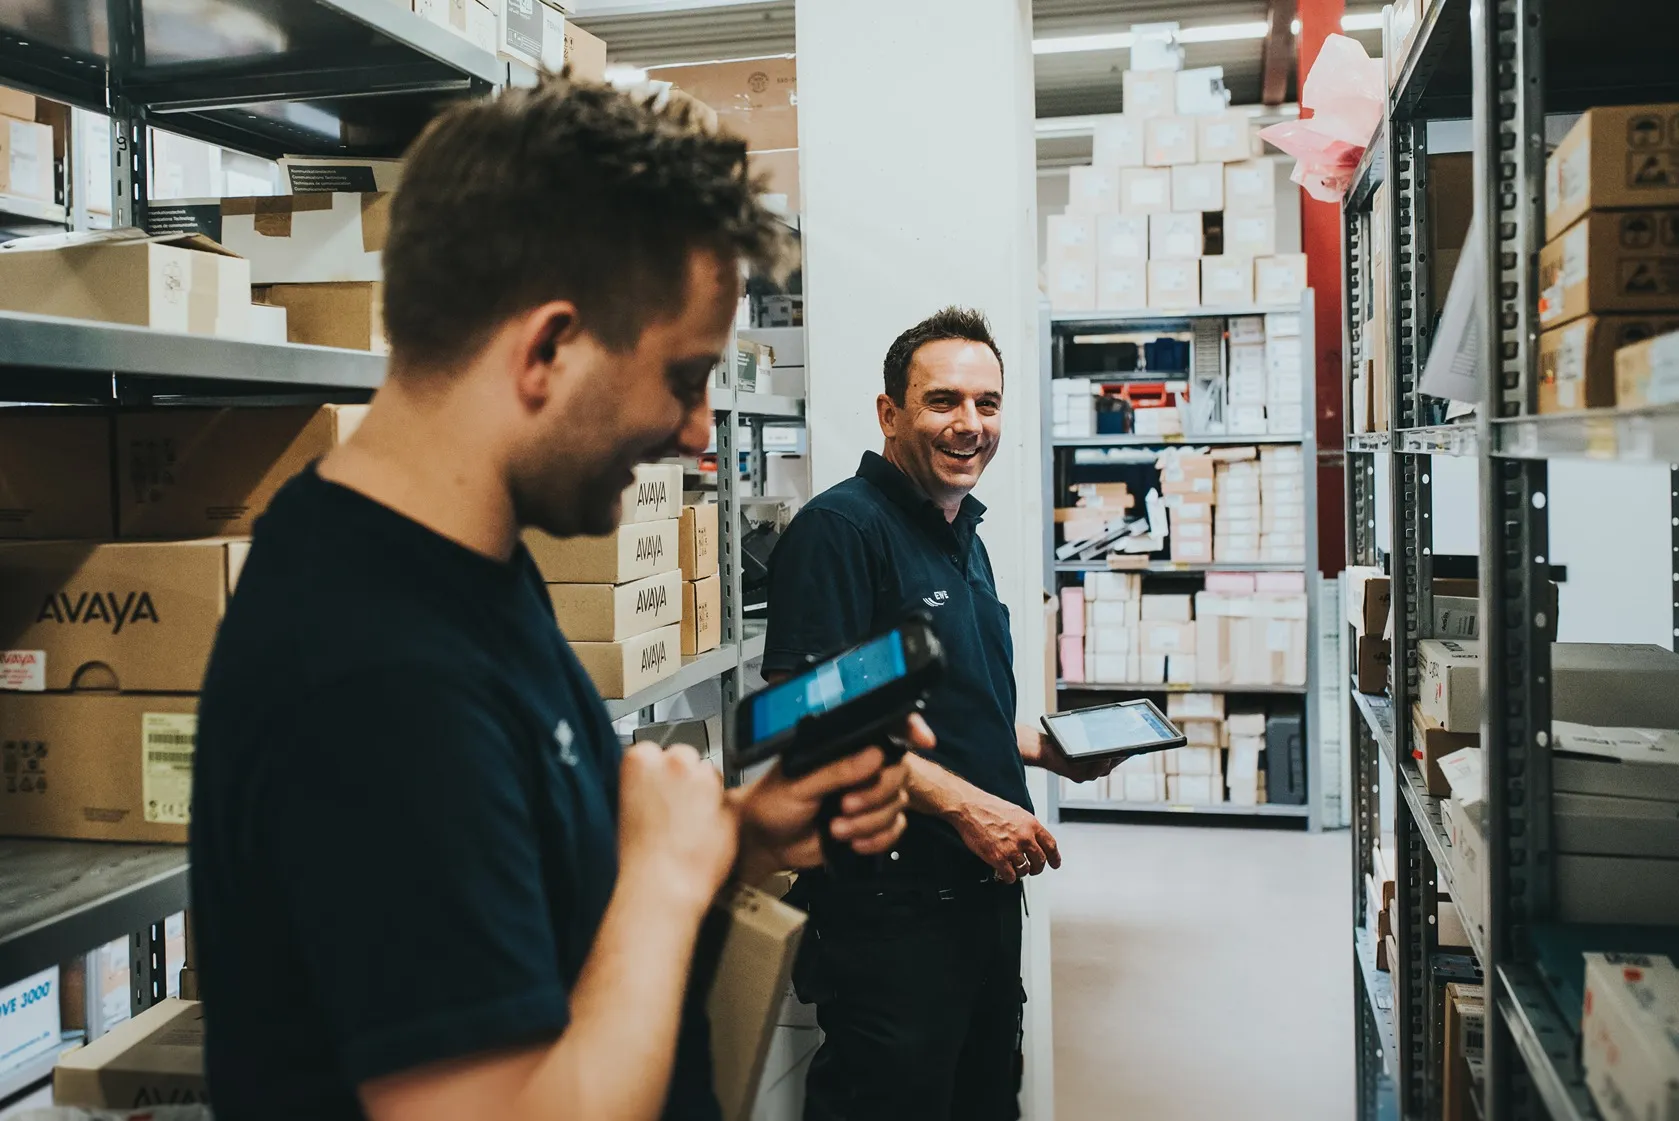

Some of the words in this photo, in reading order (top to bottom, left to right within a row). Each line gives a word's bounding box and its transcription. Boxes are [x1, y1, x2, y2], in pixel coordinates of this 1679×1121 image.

[637, 481, 667, 512] AVAYA
[636, 534, 663, 566] AVAYA
[636, 584, 667, 617] AVAYA
[934, 590, 949, 600] EWE
[36, 591, 160, 635] AVAYA
[641, 640, 667, 673] AVAYA
[0, 997, 16, 1017] VE
[20, 981, 51, 1008] 3000
